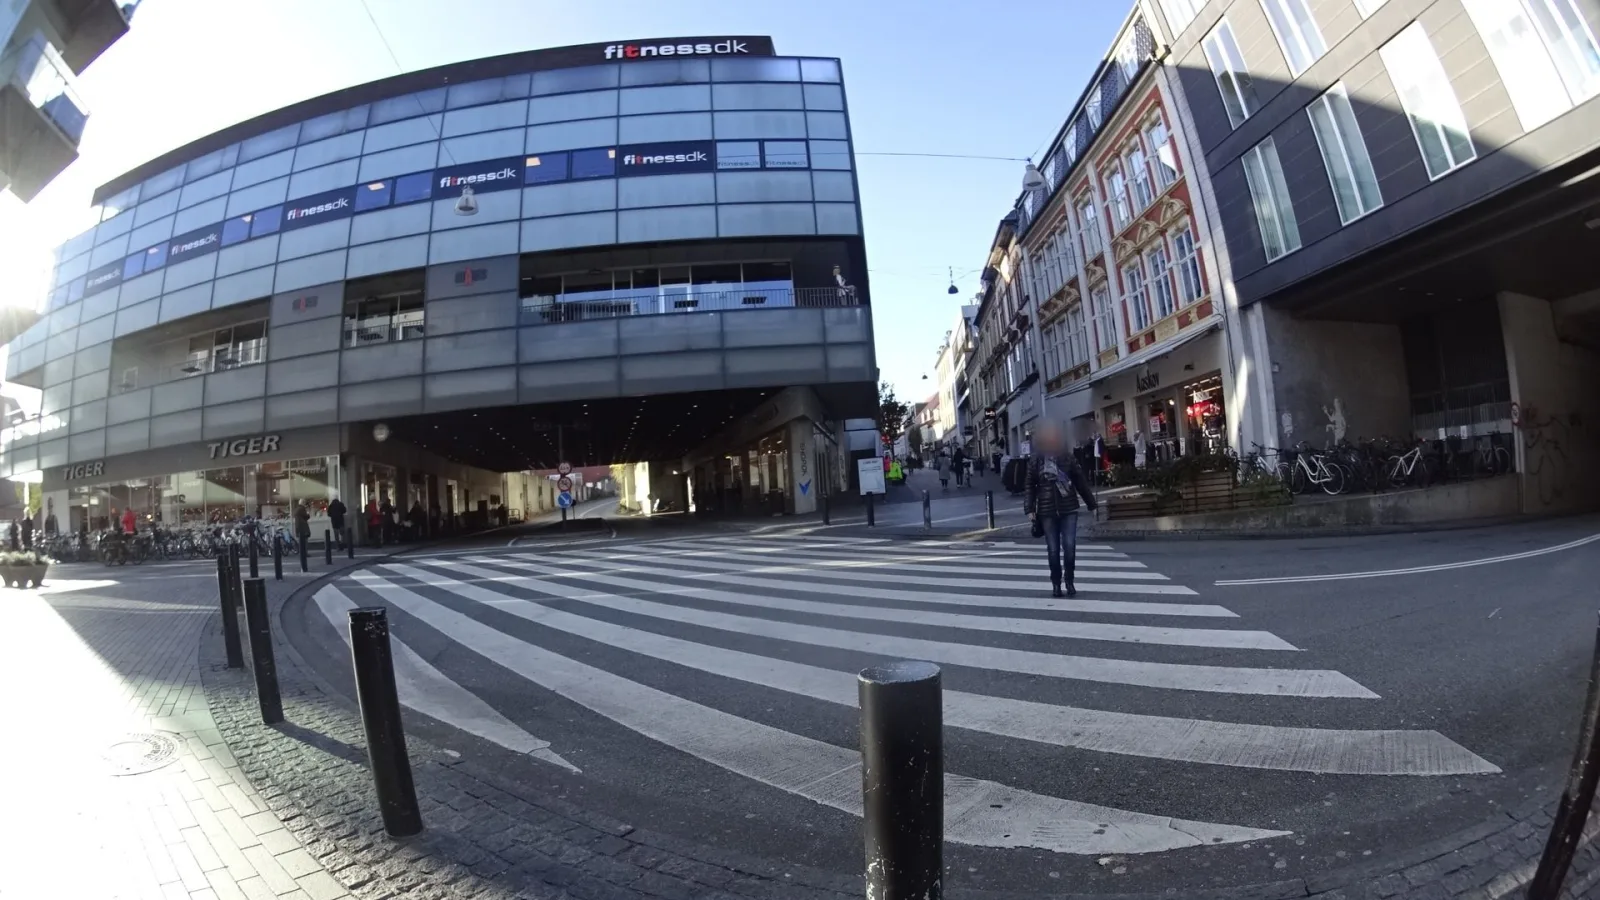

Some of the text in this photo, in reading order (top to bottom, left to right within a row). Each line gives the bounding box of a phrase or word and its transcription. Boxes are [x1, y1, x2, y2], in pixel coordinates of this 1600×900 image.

[604, 40, 749, 60] fitnessdk
[623, 151, 707, 165] fitnessdk
[440, 167, 516, 188] fitnessdk
[287, 198, 348, 220] fitnessdk
[86, 268, 121, 288] finessdk
[207, 435, 280, 459] TIGER
[62, 461, 105, 480] TIGER
